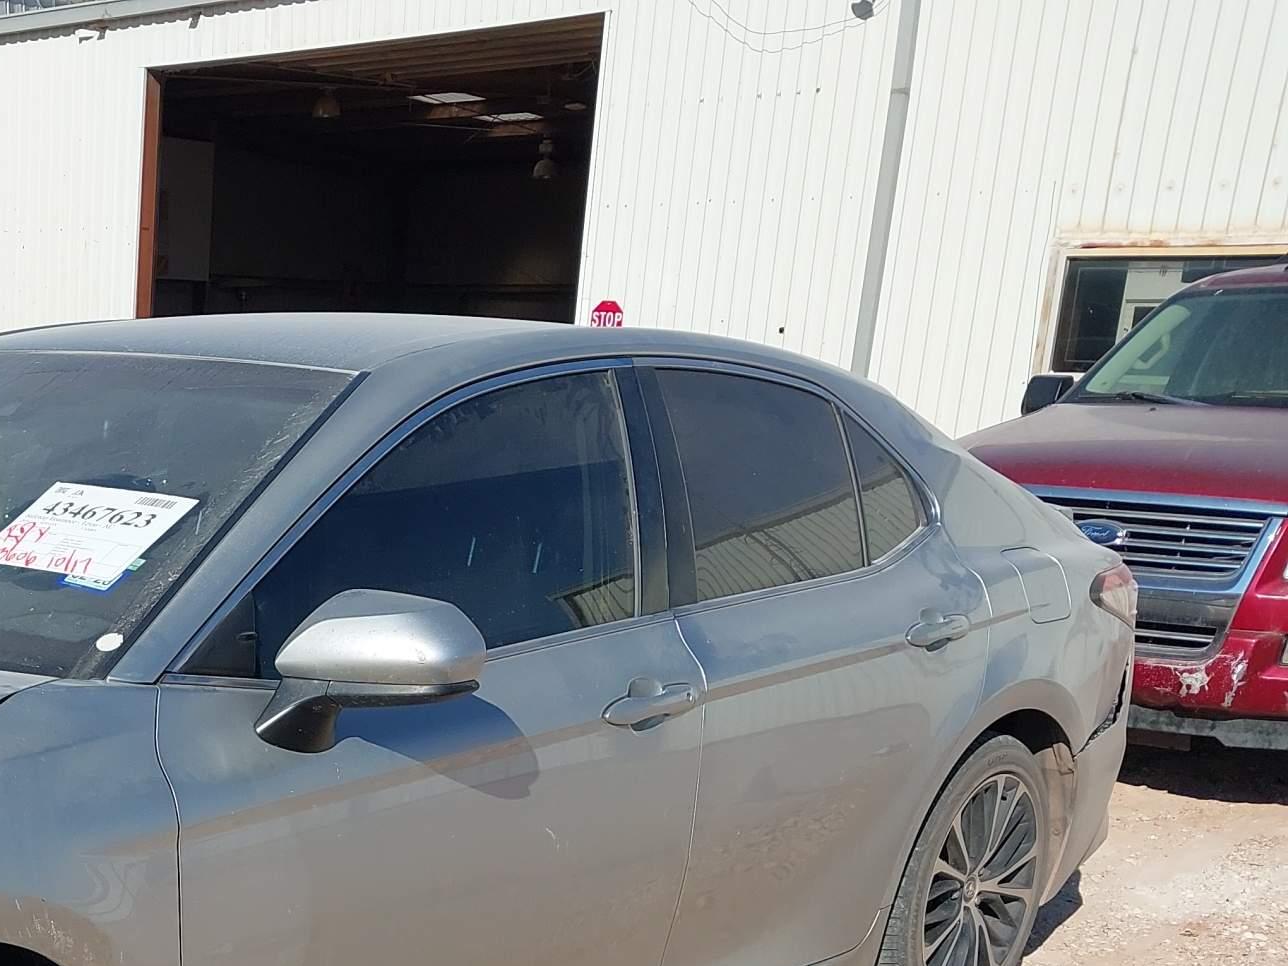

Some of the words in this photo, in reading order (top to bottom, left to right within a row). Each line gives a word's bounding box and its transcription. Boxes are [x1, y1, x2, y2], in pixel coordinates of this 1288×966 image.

[592, 311, 623, 328] STOP
[43, 500, 157, 529] 43467623
[1080, 525, 1112, 537] Ford
[46, 549, 93, 574] 10/17
